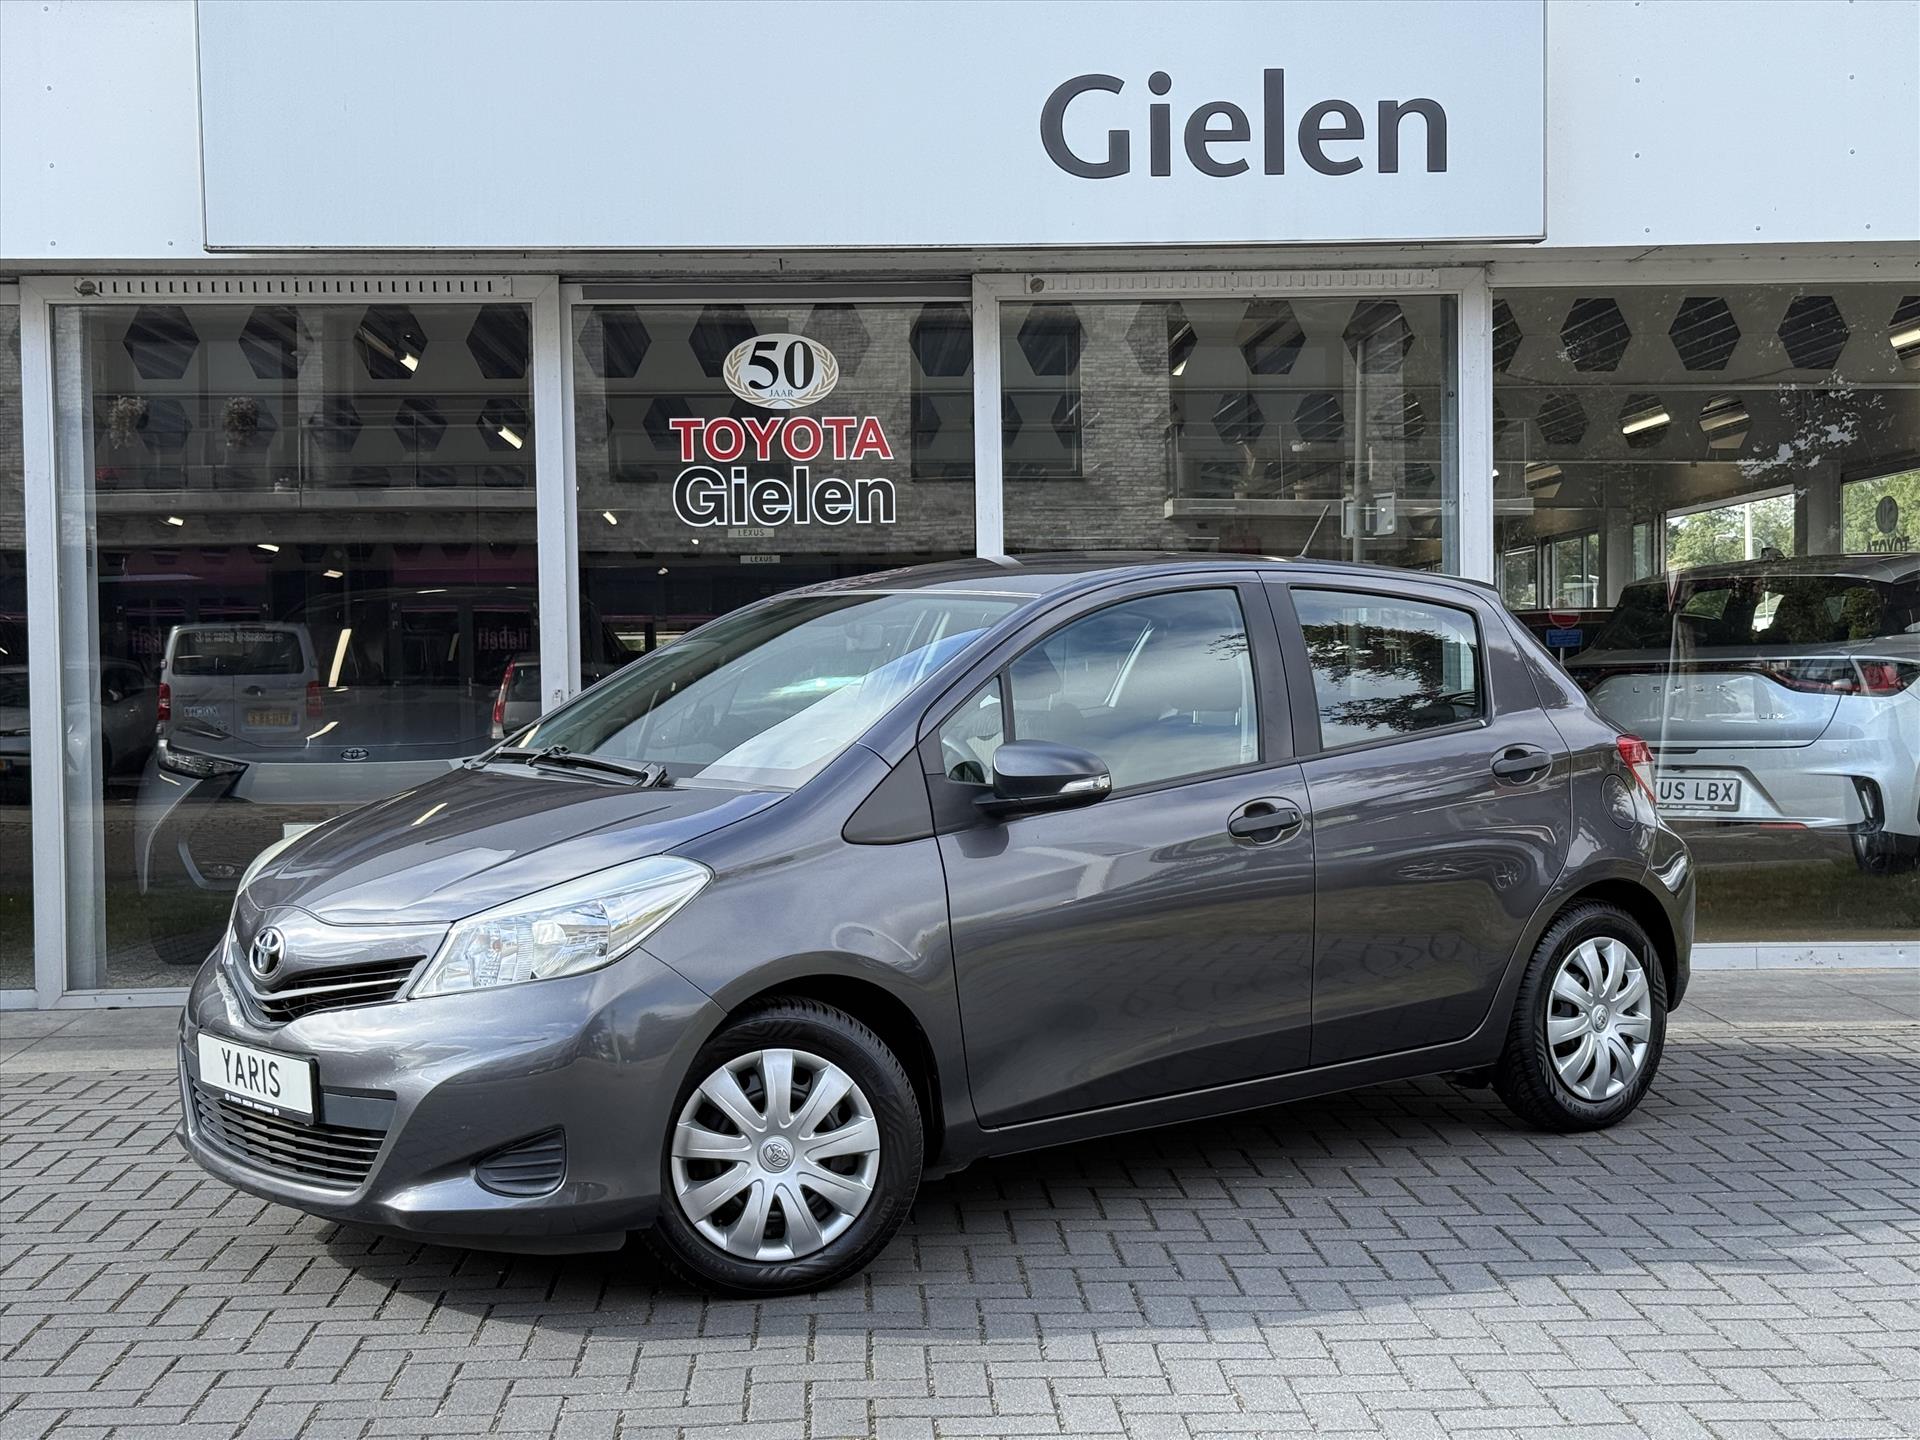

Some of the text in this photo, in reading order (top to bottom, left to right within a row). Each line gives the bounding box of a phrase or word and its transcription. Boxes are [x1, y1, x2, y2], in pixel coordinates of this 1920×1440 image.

[1040, 68, 1448, 179] Gielen
[747, 340, 815, 390] 50
[768, 389, 795, 398] JAAR
[669, 416, 895, 462] TOYOTA
[672, 465, 896, 527] Gielen
[737, 529, 765, 537] LEXUS
[750, 555, 774, 563] LEXUS
[1694, 782, 1734, 801] LBX
[221, 1047, 281, 1098] YARIS
